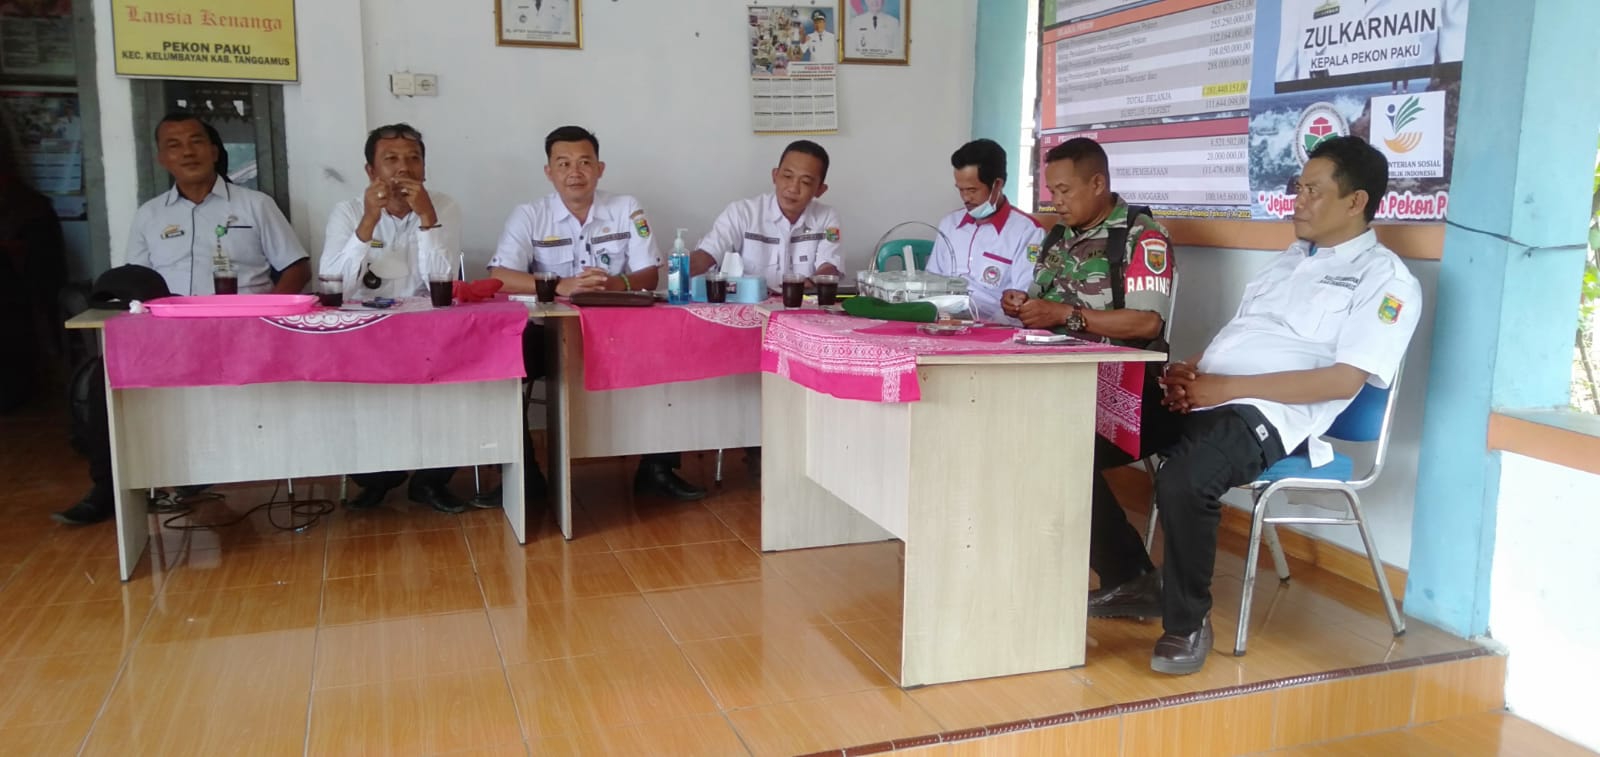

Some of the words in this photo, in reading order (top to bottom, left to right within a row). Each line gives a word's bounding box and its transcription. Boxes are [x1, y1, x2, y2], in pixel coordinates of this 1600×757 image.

[126, 5, 193, 26] Lansia
[200, 9, 283, 32] Kenanga
[1304, 8, 1437, 50] ZULKARNAIN
[163, 41, 210, 53] PEKON
[215, 43, 251, 55] PAKU
[1311, 56, 1349, 69] KEPALA
[1352, 49, 1388, 64] PEKON
[1391, 44, 1421, 58] PAKU
[122, 51, 144, 60] KEC.
[146, 52, 209, 63] KELUMBAYAN
[211, 54, 232, 64] KAB.
[234, 55, 290, 66] TANGGAMUS
[1388, 161, 1416, 169] NTERIAN
[1418, 160, 1441, 168] SOSIAL
[1389, 195, 1433, 215] Pekon
